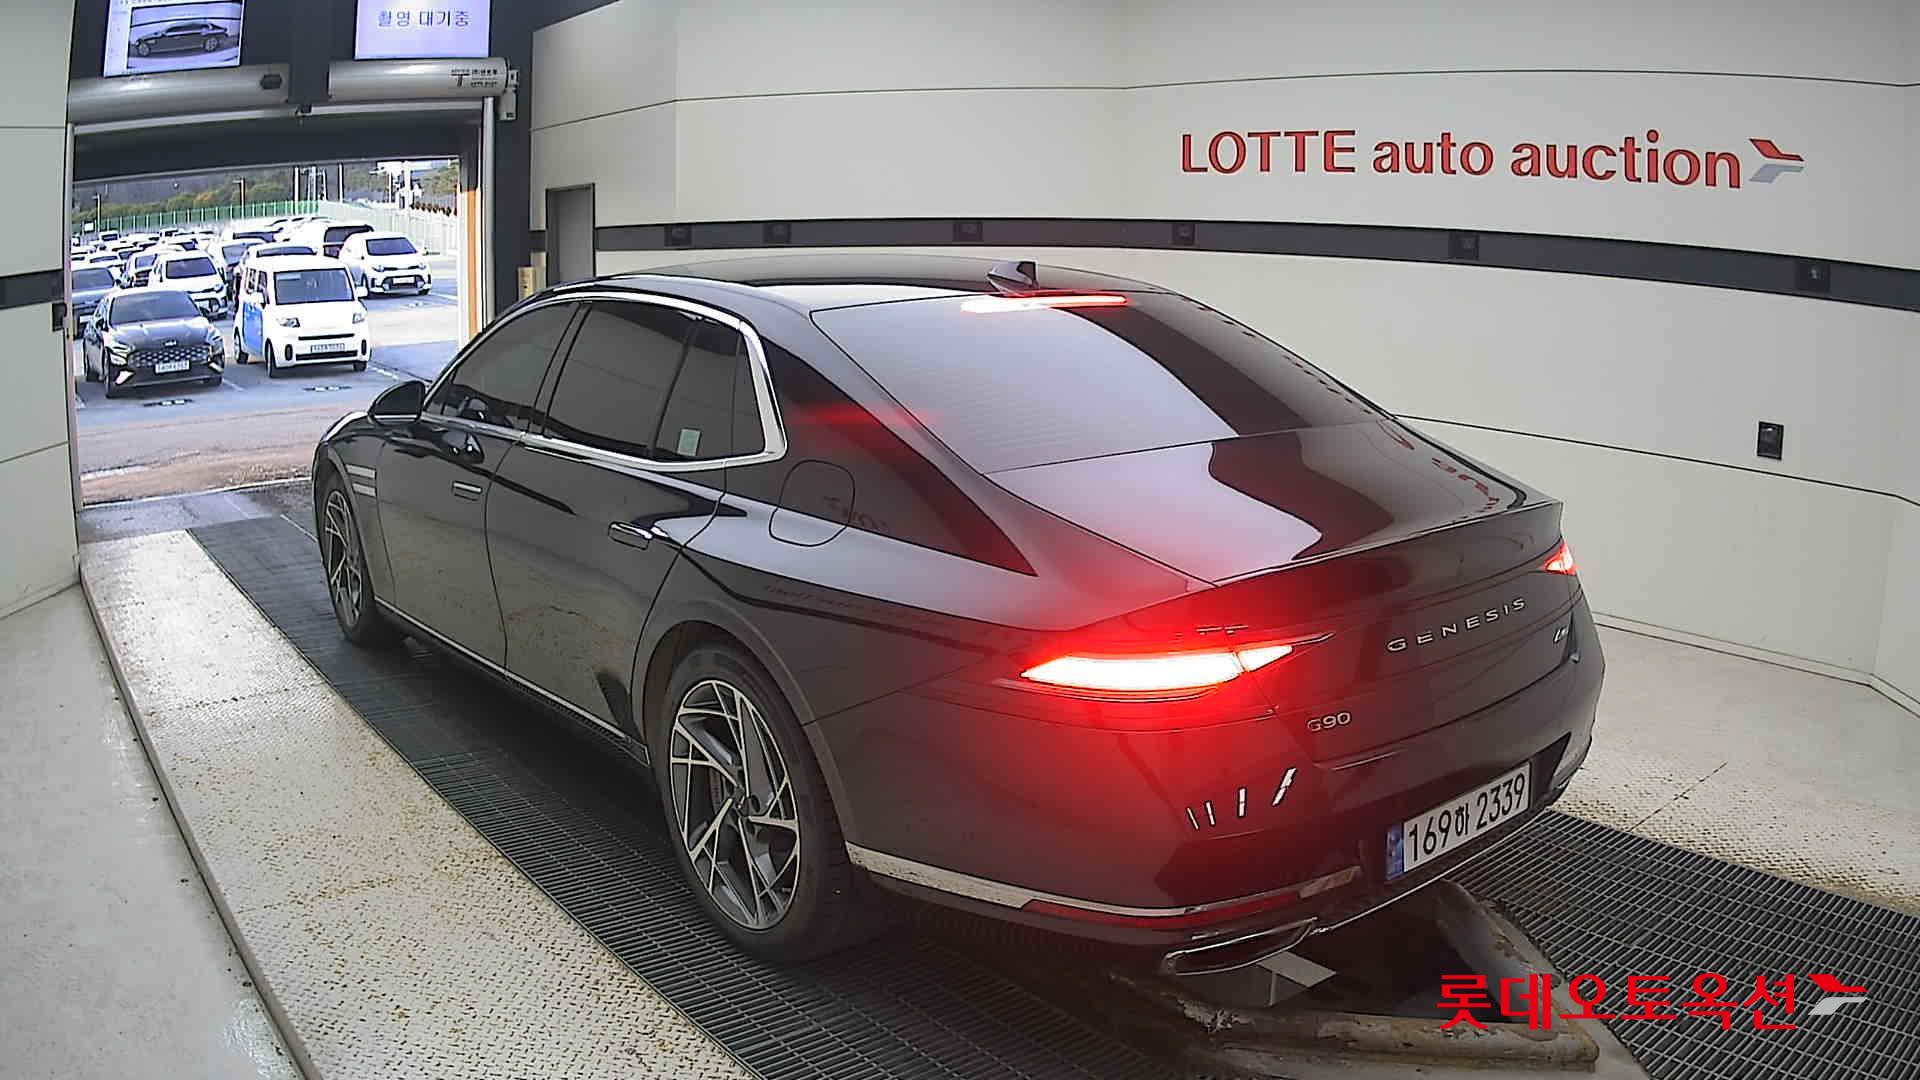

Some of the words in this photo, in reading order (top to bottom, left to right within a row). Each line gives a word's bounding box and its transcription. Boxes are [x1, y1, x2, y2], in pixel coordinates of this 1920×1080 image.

[1181, 129, 1356, 174] LOTTE
[1372, 131, 1494, 176] auto
[1510, 129, 1741, 189] auction
[1386, 597, 1527, 652] GENESIS
[1306, 711, 1352, 732] G90
[1408, 802, 1470, 862] 169하
[1475, 772, 1526, 831] 2339
